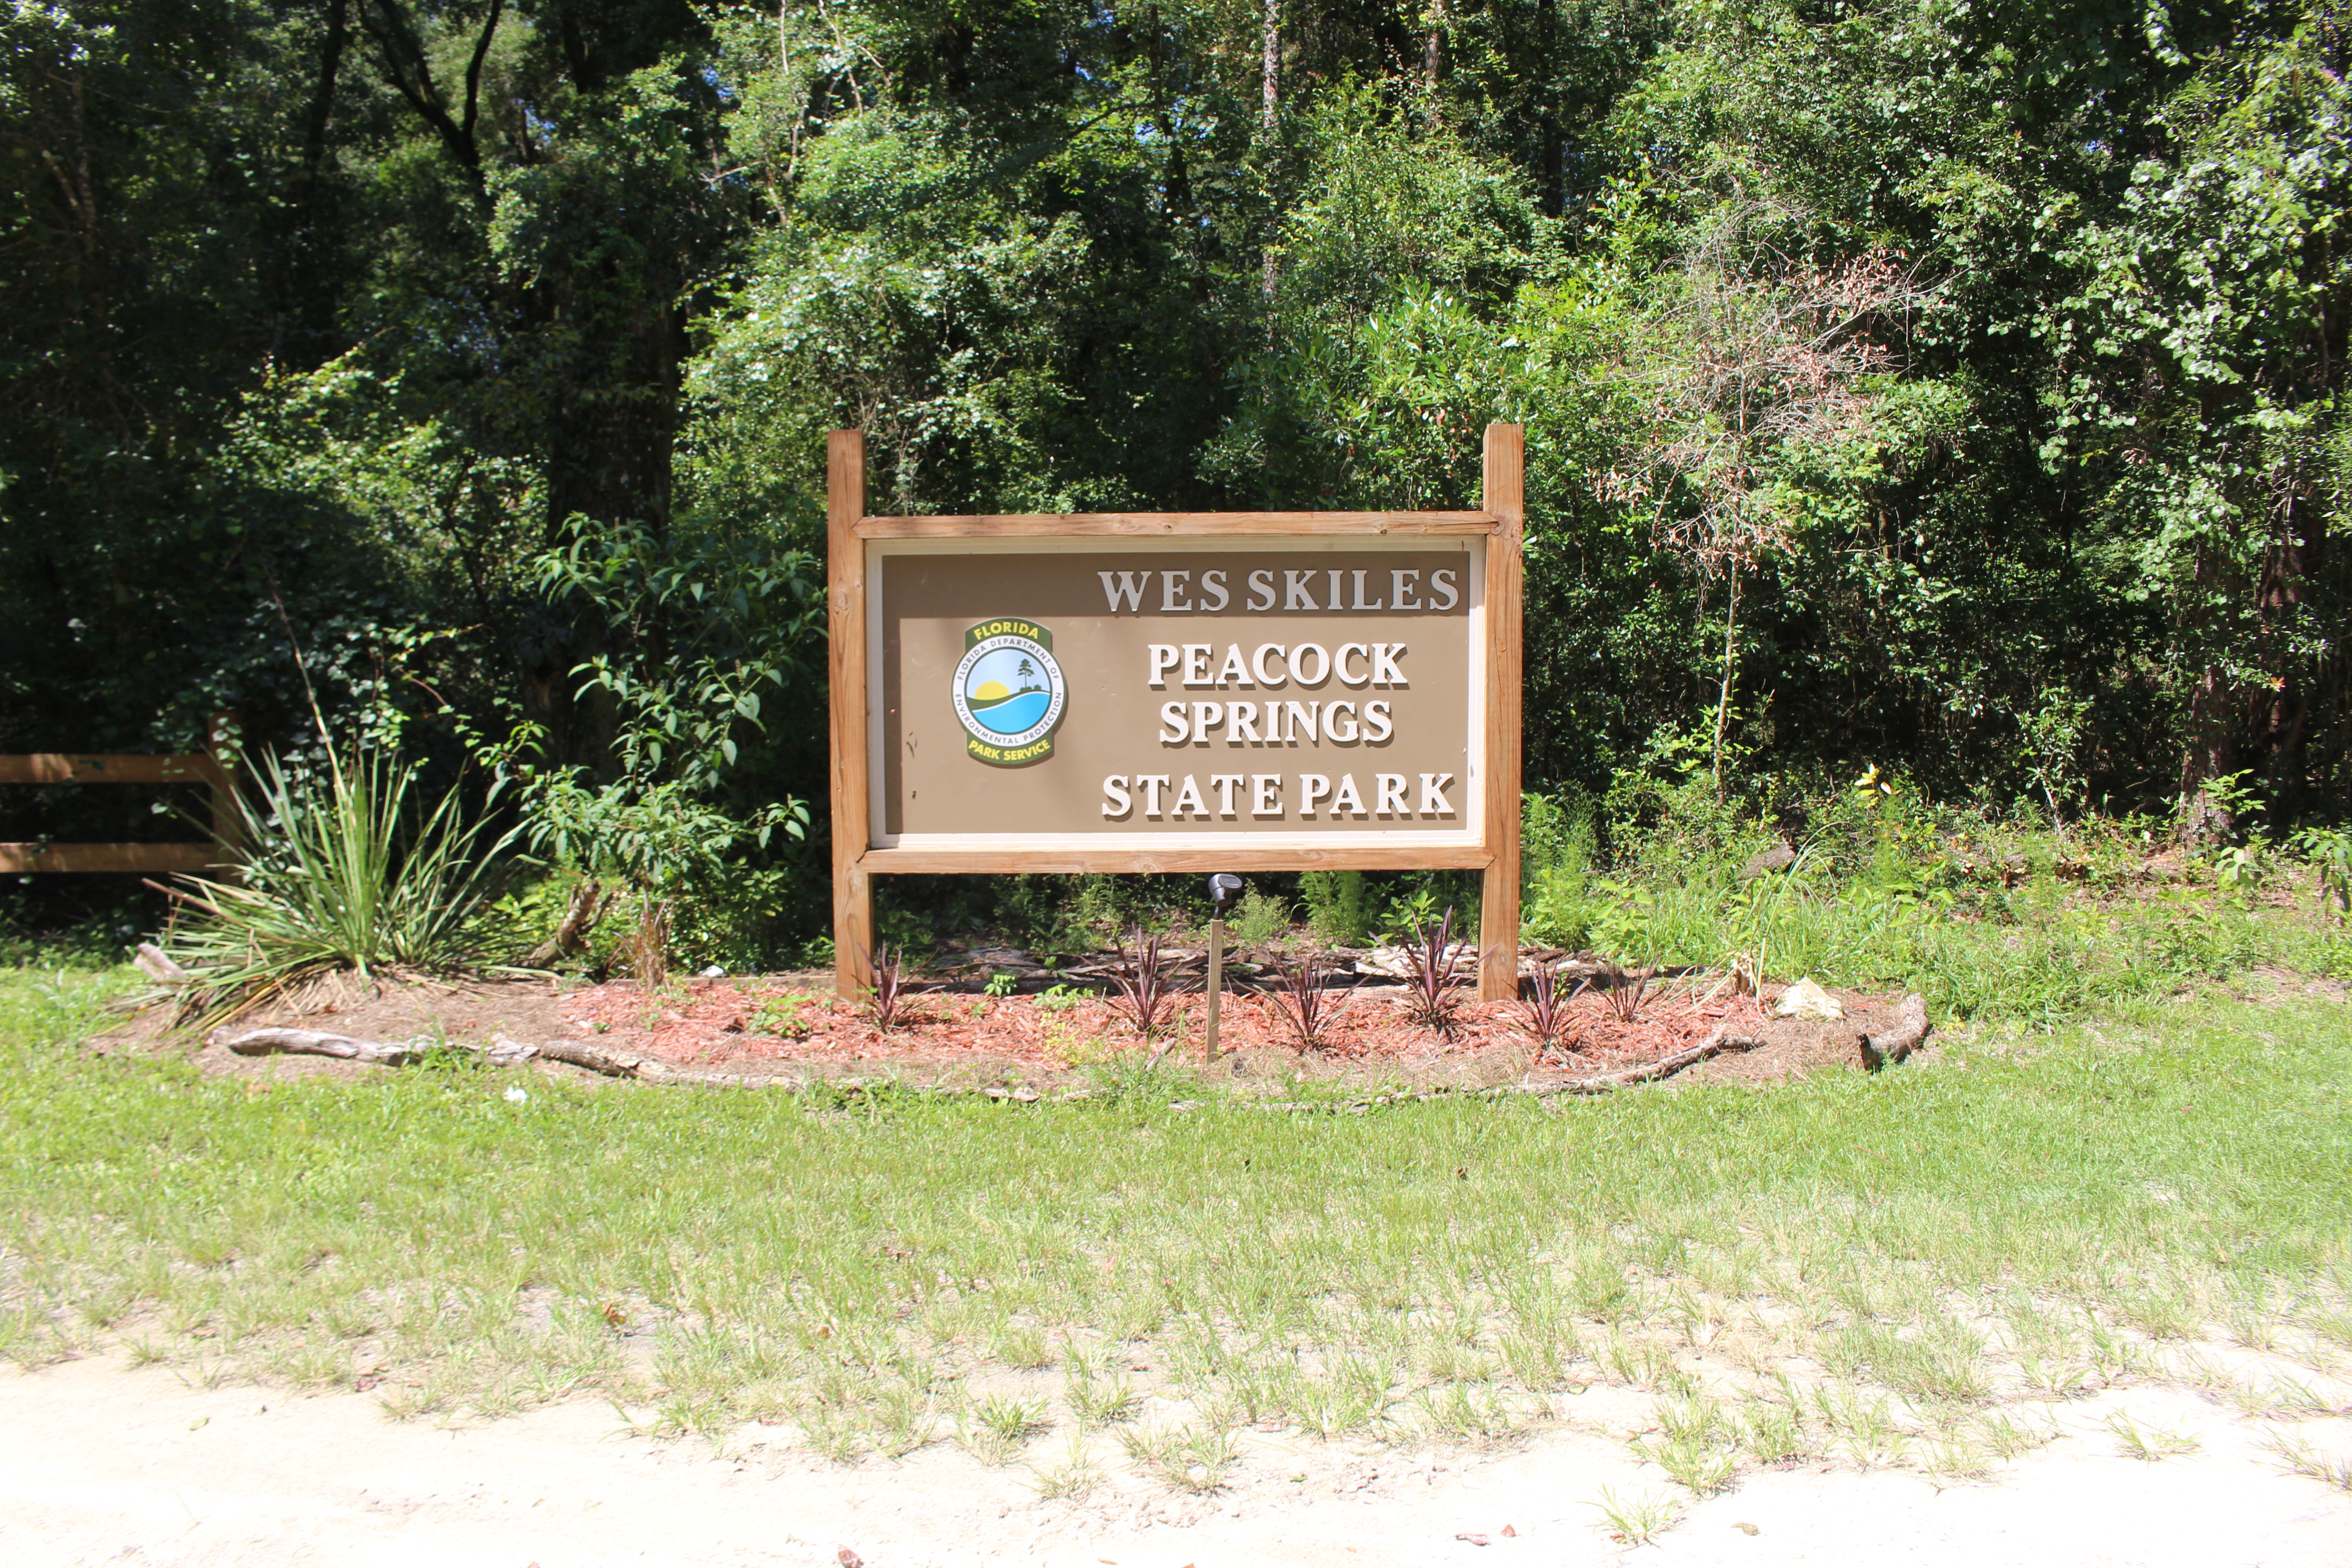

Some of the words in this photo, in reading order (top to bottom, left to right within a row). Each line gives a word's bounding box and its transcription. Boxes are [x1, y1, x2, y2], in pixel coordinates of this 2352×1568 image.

[1098, 570, 1230, 612] WES
[1247, 569, 1459, 611] SKILES
[974, 621, 1039, 640] FLORIDA
[958, 645, 986, 680] FLORIDA
[991, 638, 1051, 663] DEPARTMENT
[1050, 667, 1059, 679] OF
[1148, 643, 1408, 685] PEACOCK
[956, 694, 1019, 744] ENVIRONMENTAL
[1024, 692, 1061, 741] PROTECTION
[1160, 701, 1392, 743] SPRINGS
[969, 740, 1001, 760] PARK
[1004, 739, 1050, 760] SERVICE
[1102, 774, 1283, 816] STATE
[1299, 774, 1455, 815] PARK
